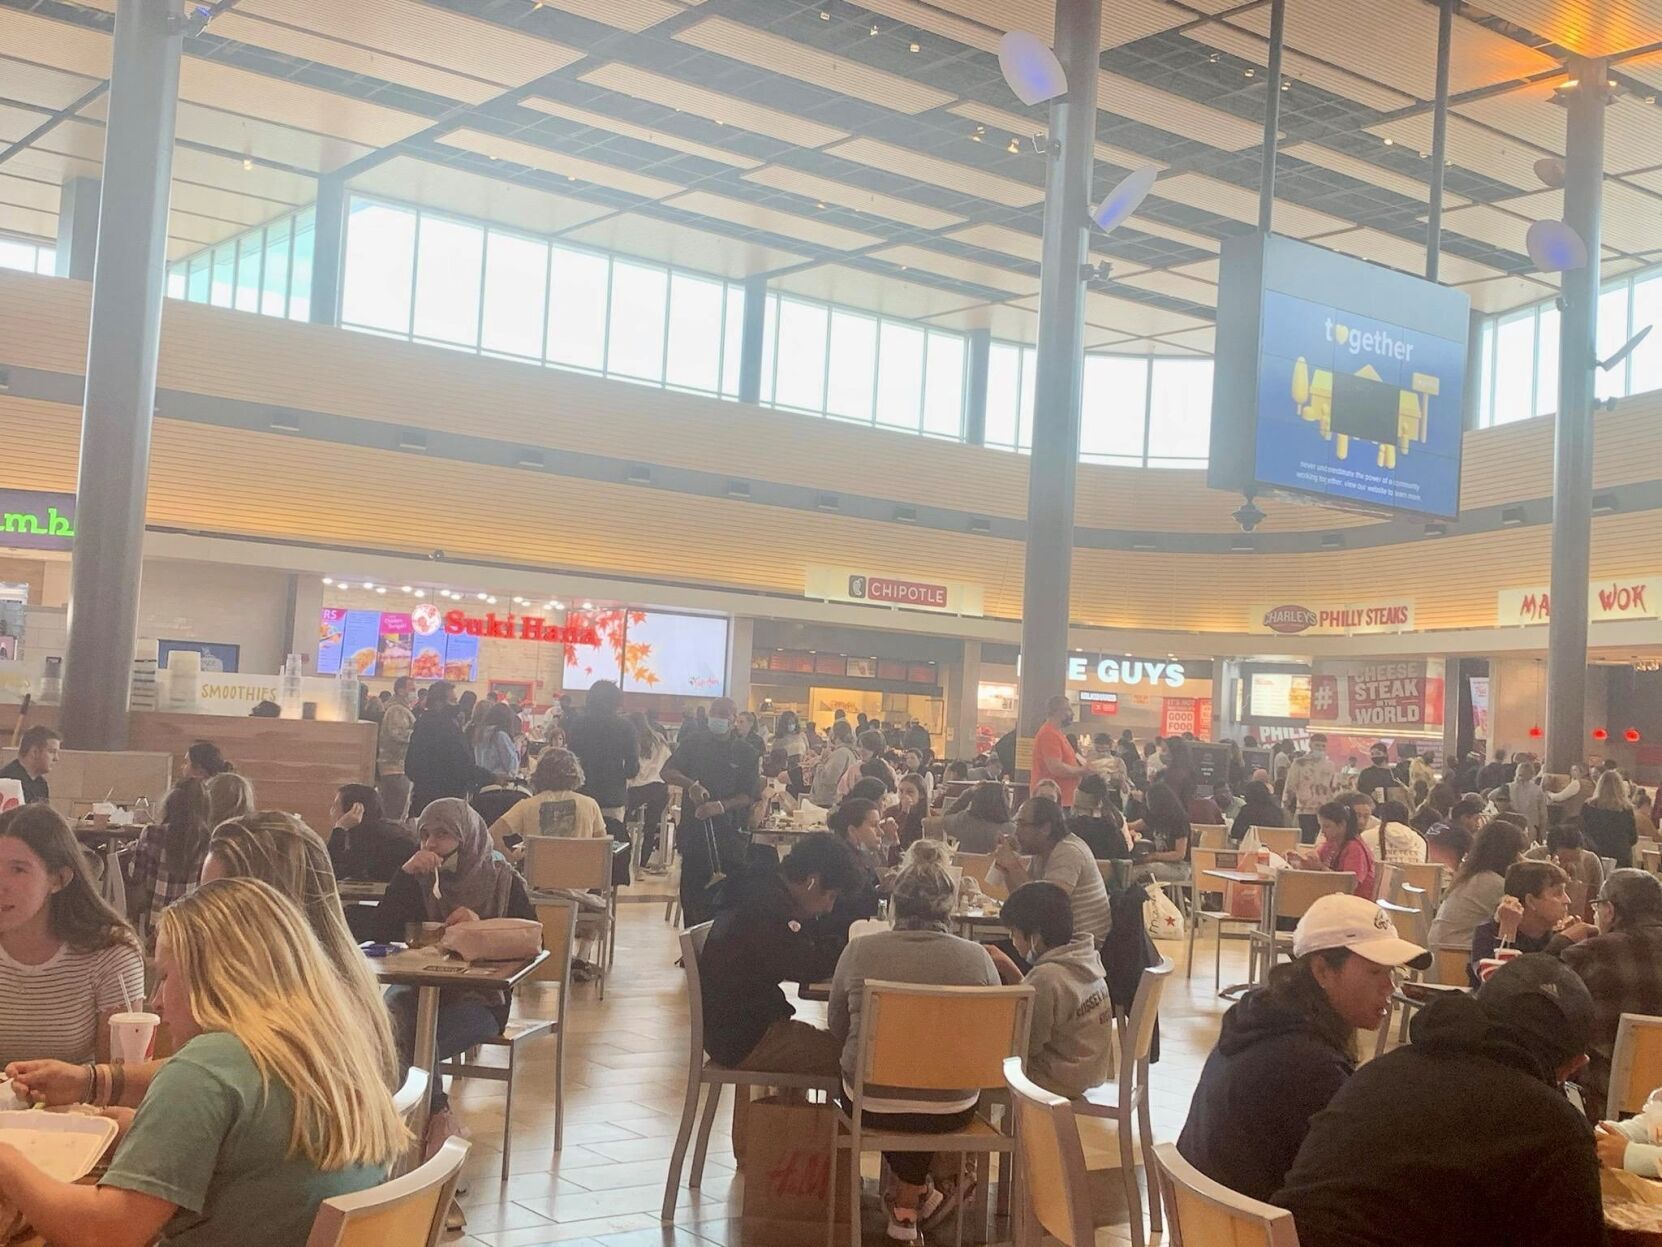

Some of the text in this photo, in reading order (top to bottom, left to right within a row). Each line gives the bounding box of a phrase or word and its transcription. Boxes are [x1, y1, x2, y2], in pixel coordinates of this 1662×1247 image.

[1325, 318, 1414, 361] together
[0, 508, 76, 536] mb
[871, 583, 944, 603] CHIPOTLE
[1520, 582, 1647, 621] MA WOK
[444, 609, 601, 646] Suki Hana
[1263, 606, 1408, 628] CHARLEYS PHILLY STEAKS
[1097, 659, 1185, 688] GUYS
[1354, 662, 1418, 682] CHEESE
[201, 684, 277, 702] SMOOTHIES
[1354, 679, 1419, 701] STEAK
[1168, 712, 1193, 722] GOOD
[1354, 705, 1420, 725] WORLD
[1168, 722, 1193, 731] FOOD
[1260, 726, 1310, 742] PHILL
